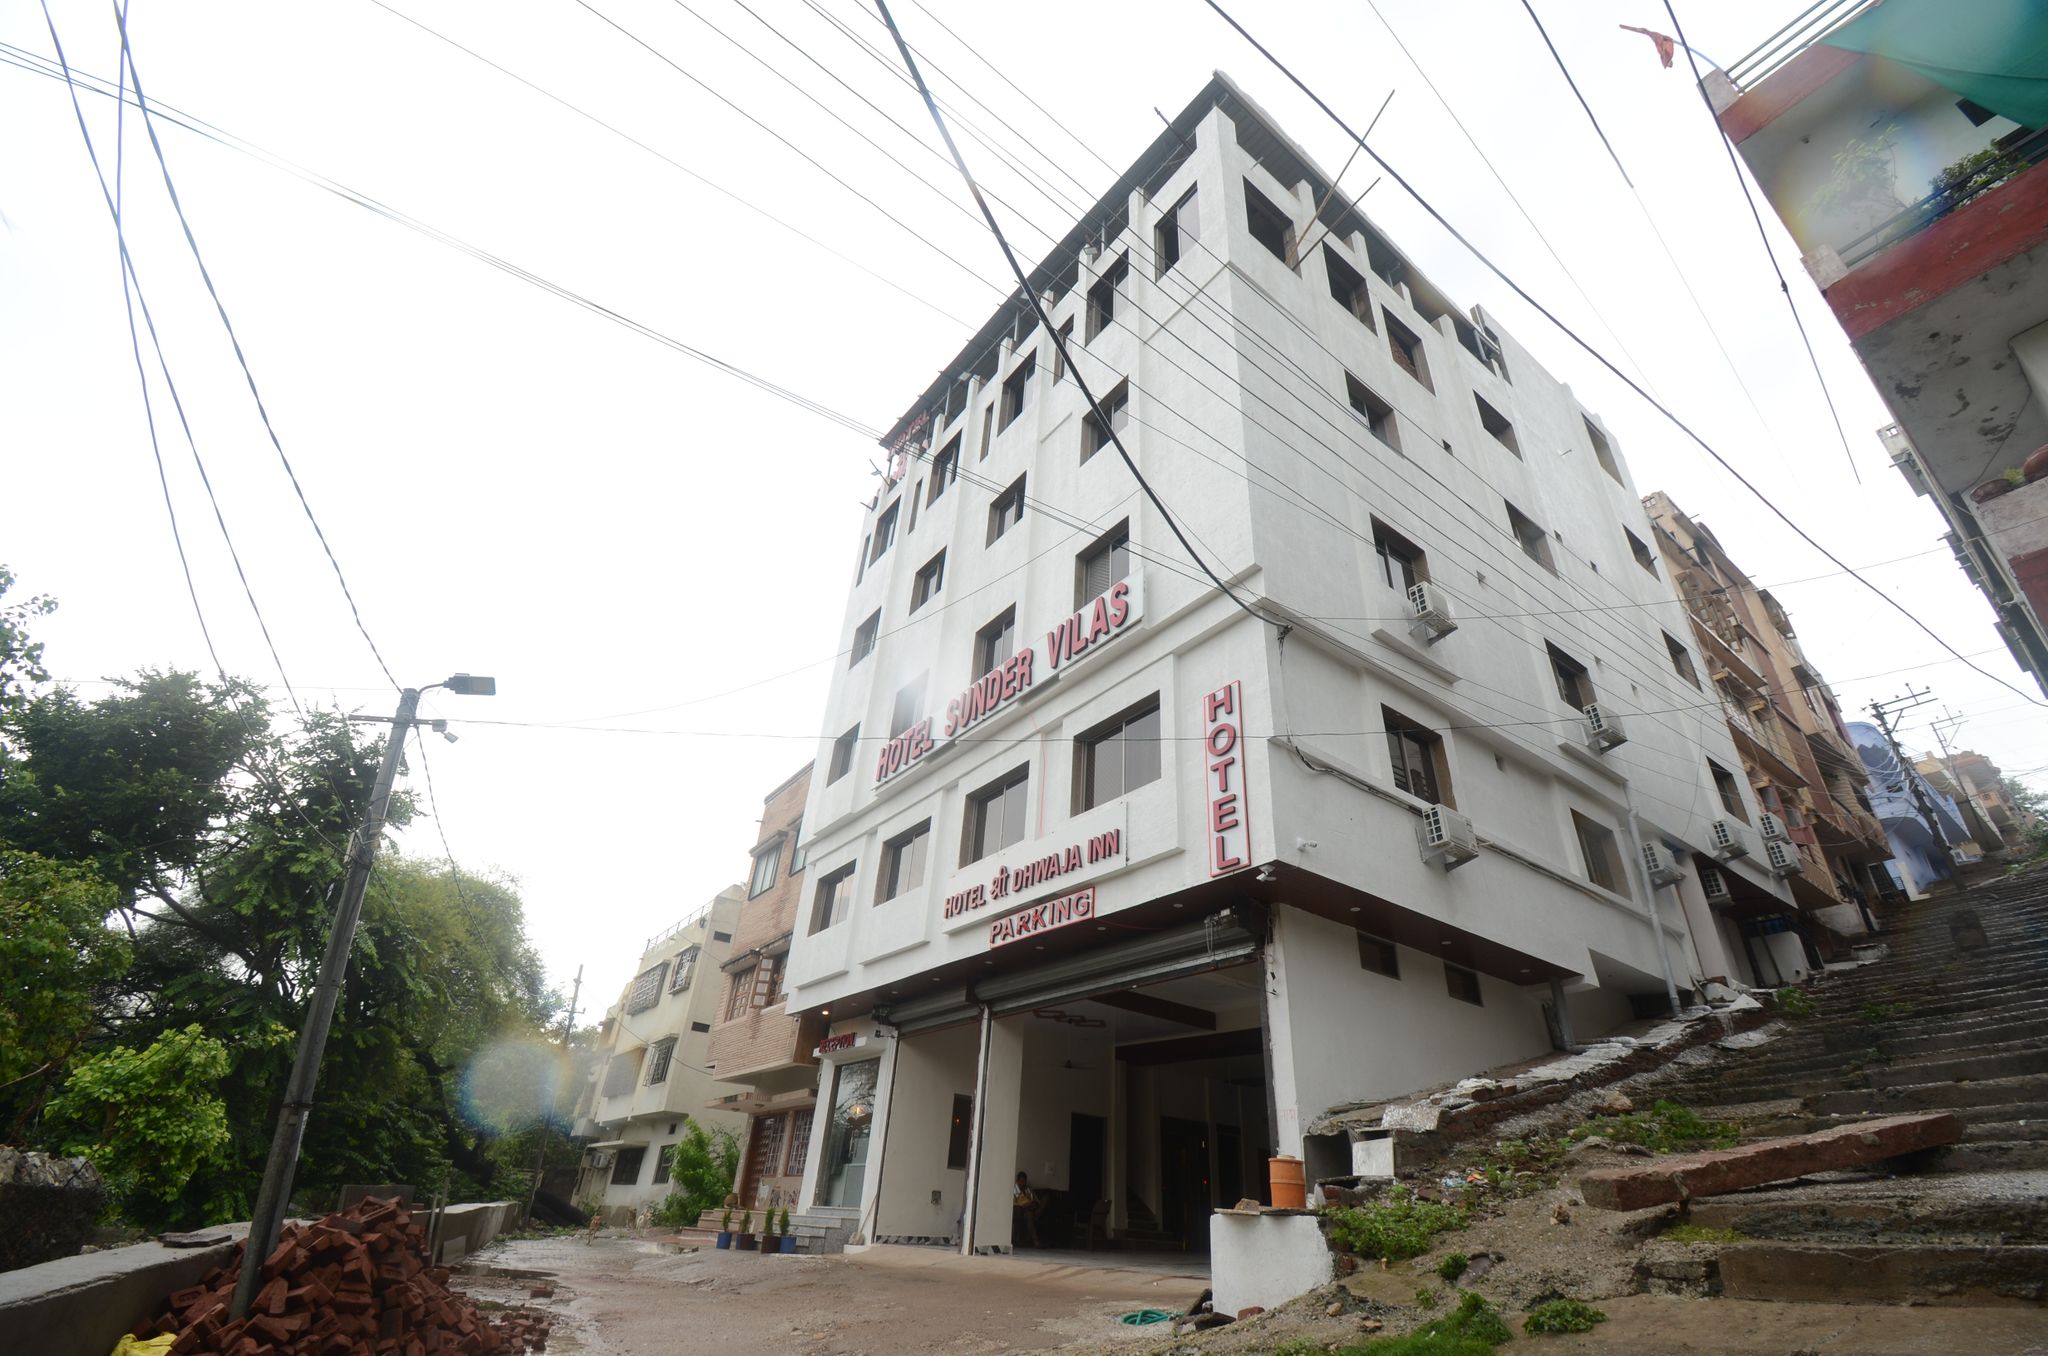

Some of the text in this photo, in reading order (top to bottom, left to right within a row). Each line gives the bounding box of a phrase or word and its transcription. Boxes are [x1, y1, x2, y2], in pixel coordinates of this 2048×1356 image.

[875, 582, 1129, 782] HOTEL SUNDER VILAS
[1207, 684, 1241, 871] HOTEL
[943, 828, 1120, 919] HOTEL श्री DHWAJA INN
[990, 892, 1090, 944] PARKING
